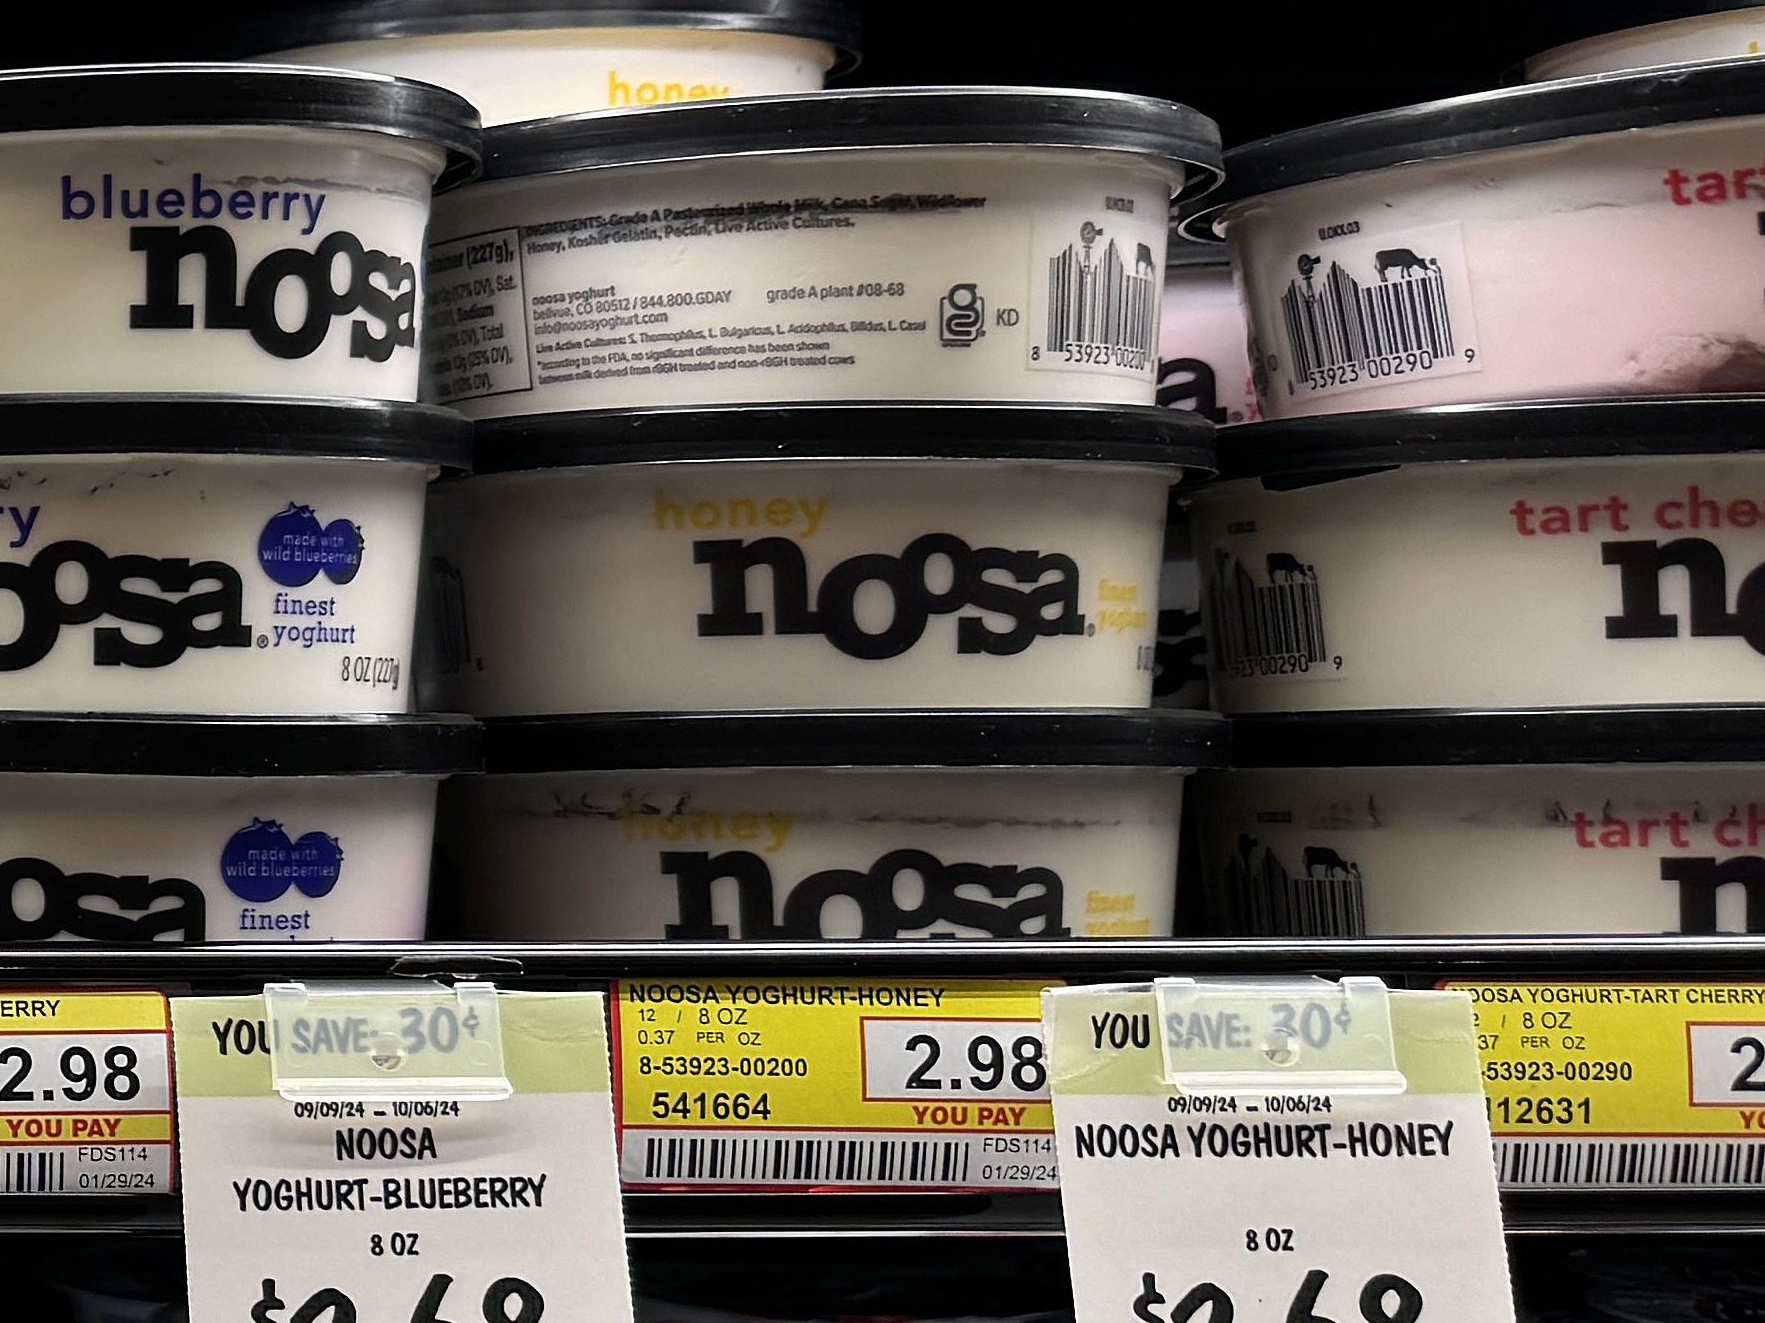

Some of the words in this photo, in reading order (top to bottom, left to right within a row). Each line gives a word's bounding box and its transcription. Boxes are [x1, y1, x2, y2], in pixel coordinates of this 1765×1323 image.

[336, 1127, 438, 1161] NOOSA
[1075, 1123, 1180, 1162] NOOSA
[1185, 1121, 1454, 1162] YOGHURT-HONEY
[233, 1175, 546, 1214] YOGHURT-BLUEBERRY
